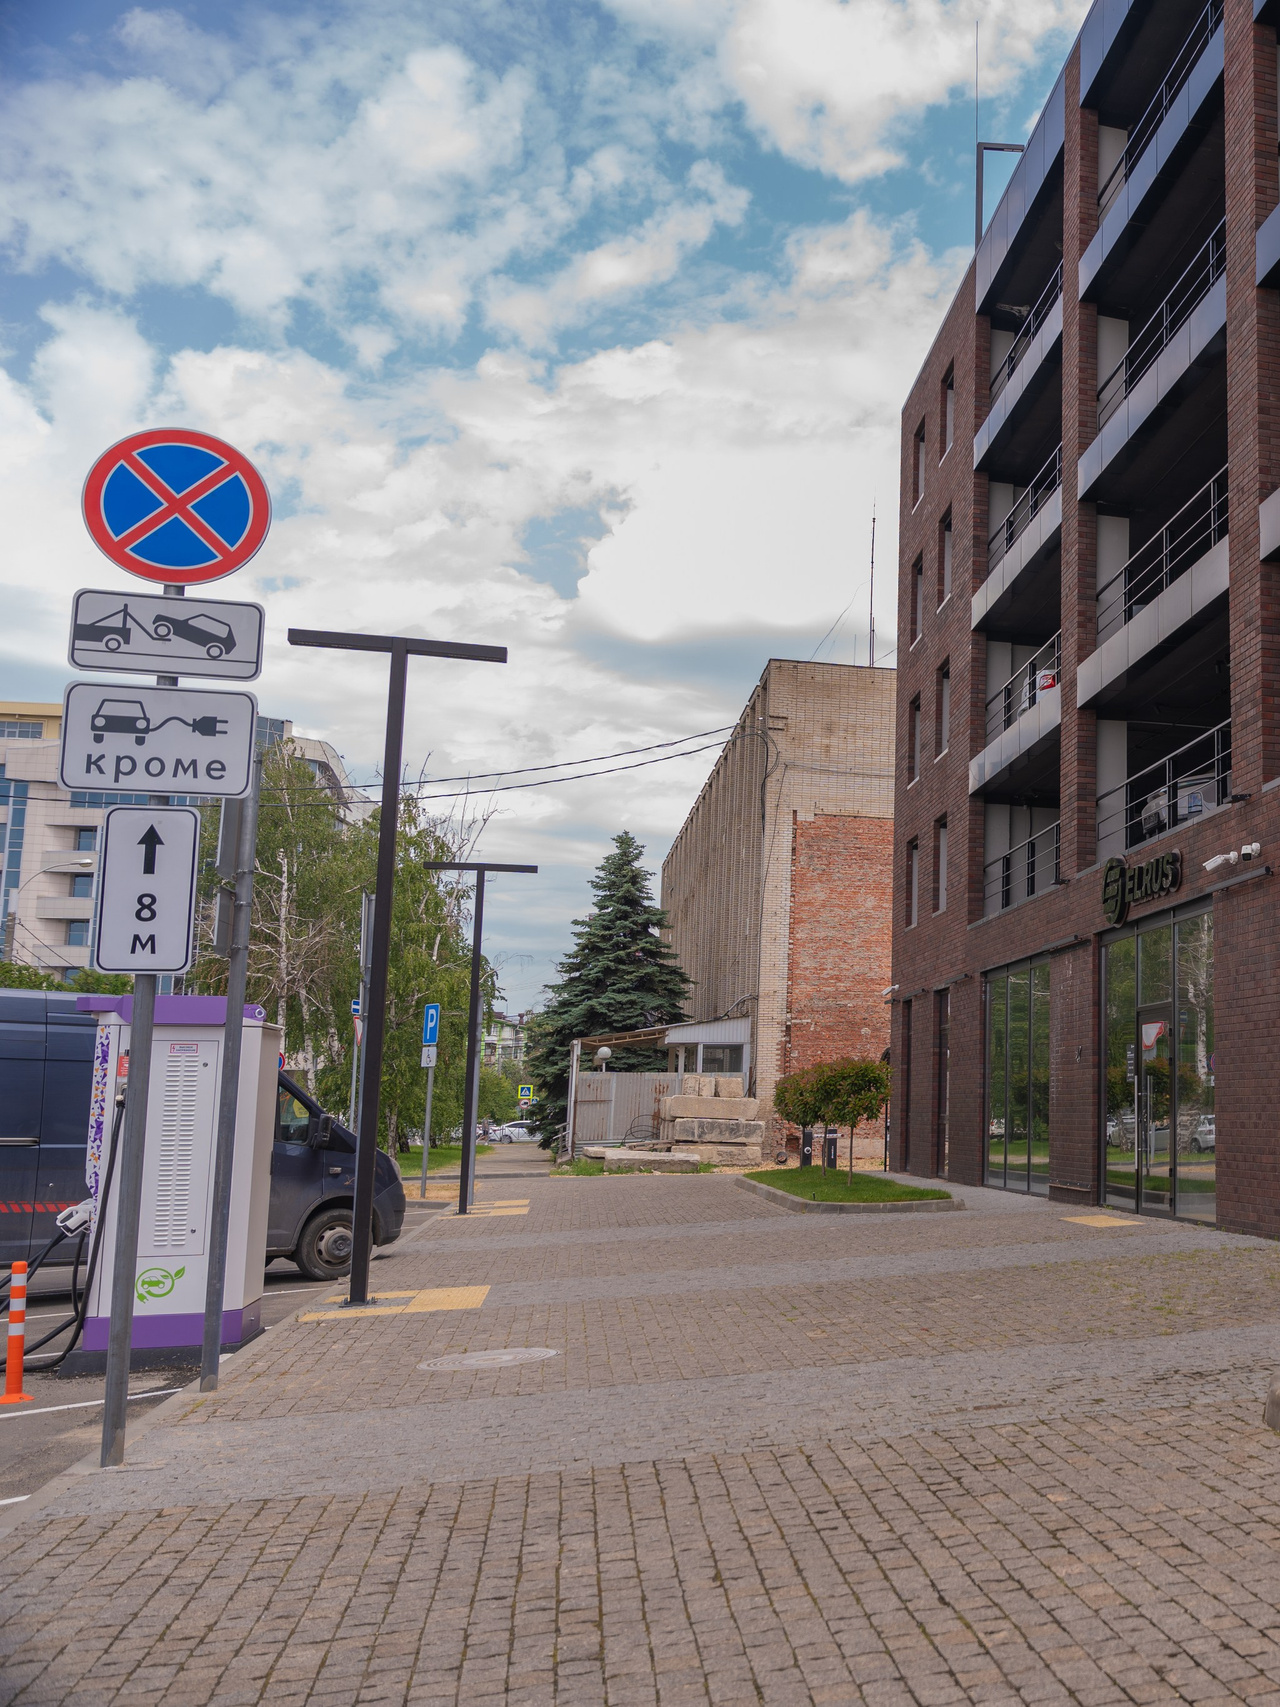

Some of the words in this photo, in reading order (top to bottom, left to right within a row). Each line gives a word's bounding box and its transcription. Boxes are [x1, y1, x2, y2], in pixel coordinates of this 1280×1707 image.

[85, 753, 227, 783] кроме
[1125, 851, 1178, 903] ELRUS
[134, 893, 157, 922] 8
[426, 1008, 437, 1040] P
